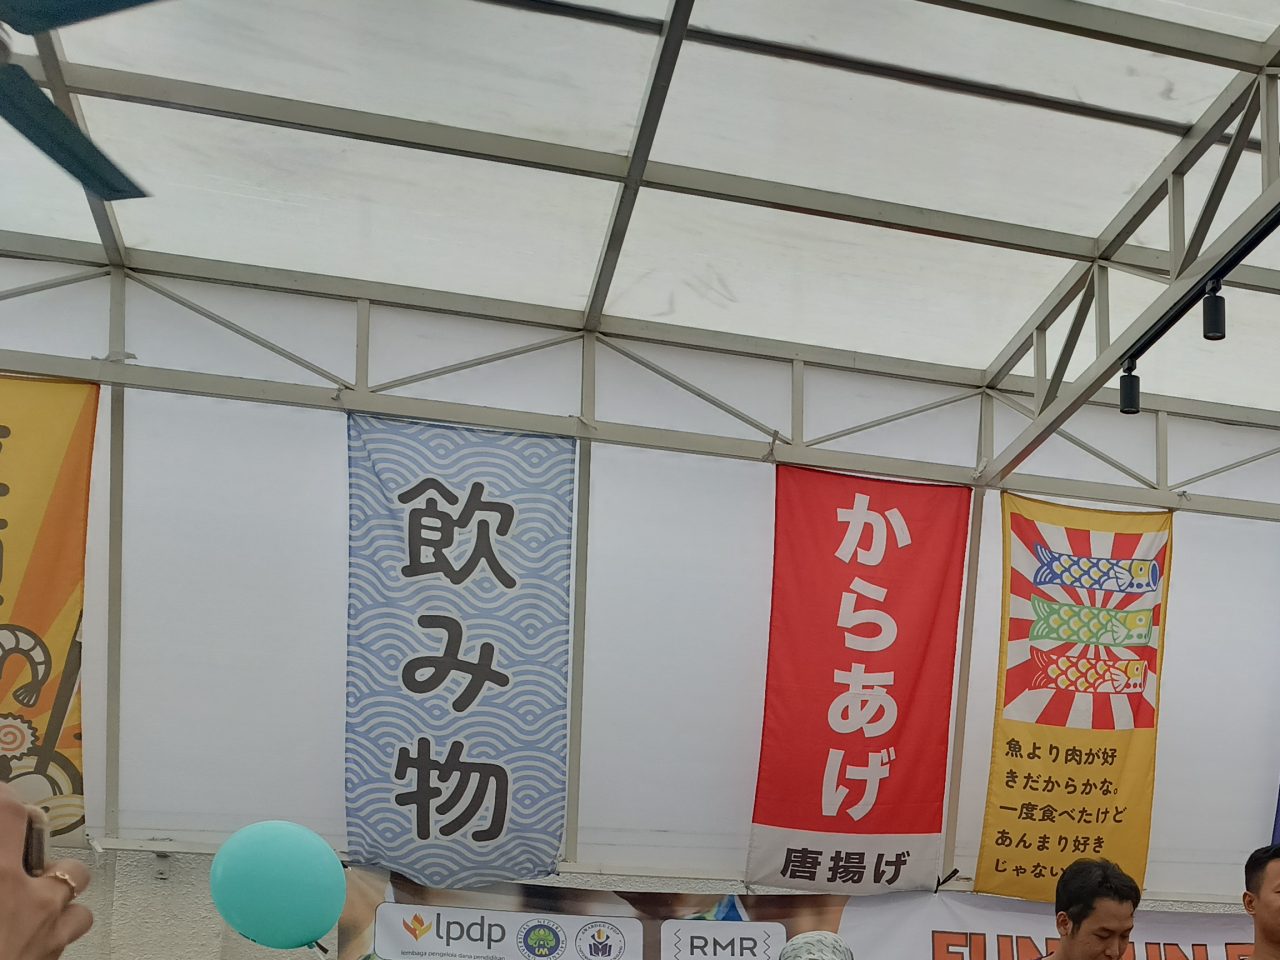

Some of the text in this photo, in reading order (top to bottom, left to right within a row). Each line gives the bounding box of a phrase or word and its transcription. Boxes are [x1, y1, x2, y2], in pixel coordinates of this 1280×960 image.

[394, 478, 517, 842] 飲み物
[821, 492, 912, 822] からあげ
[1005, 738, 1118, 766] 魚より肉が好
[999, 802, 1127, 824] 一度食べたけど
[994, 829, 1105, 853] あんまり好き
[780, 847, 911, 885] 唐揚げ
[435, 912, 506, 950] lpdp
[689, 935, 758, 957] RMR
